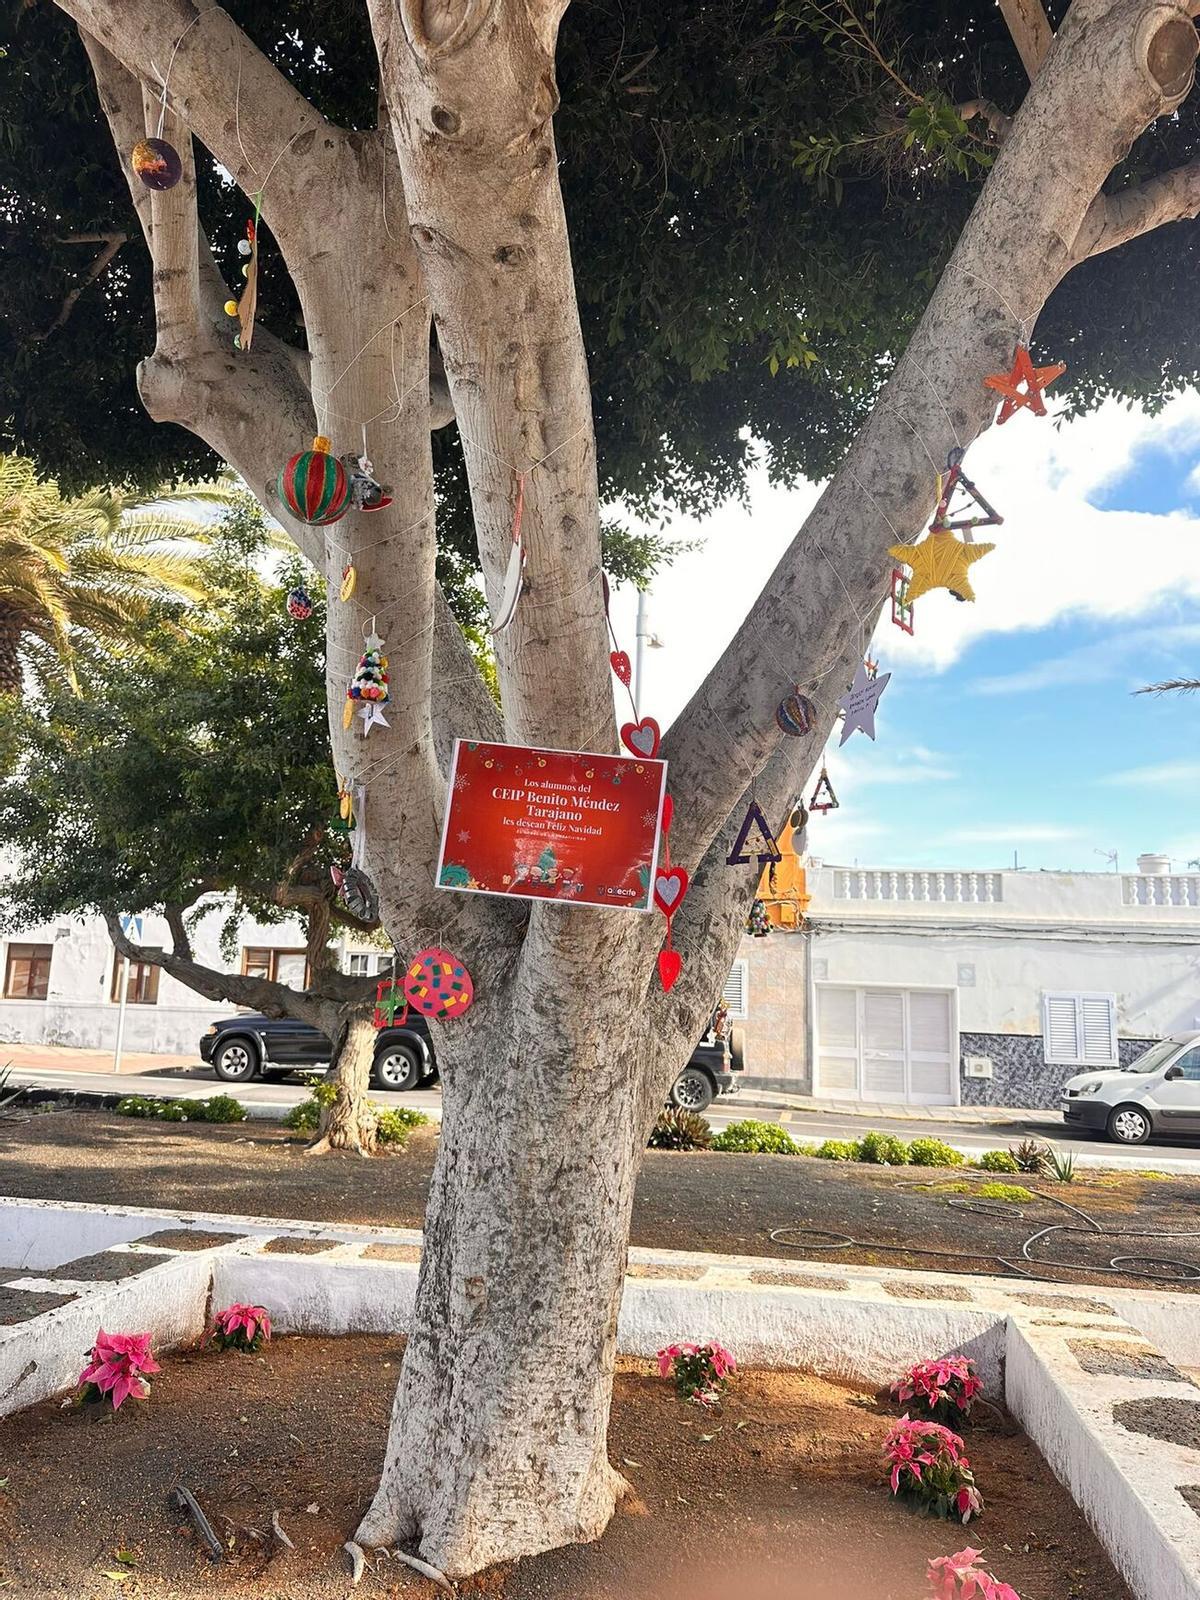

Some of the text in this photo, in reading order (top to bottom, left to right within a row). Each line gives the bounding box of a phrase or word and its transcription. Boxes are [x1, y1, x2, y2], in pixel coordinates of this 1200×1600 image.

[525, 778, 591, 793] Los alumnos del
[492, 787, 620, 812] CEIP Benito Méndez
[526, 804, 582, 822] Tarajano
[503, 816, 515, 826] les
[516, 818, 545, 829] desean
[568, 824, 602, 835] Navidad
